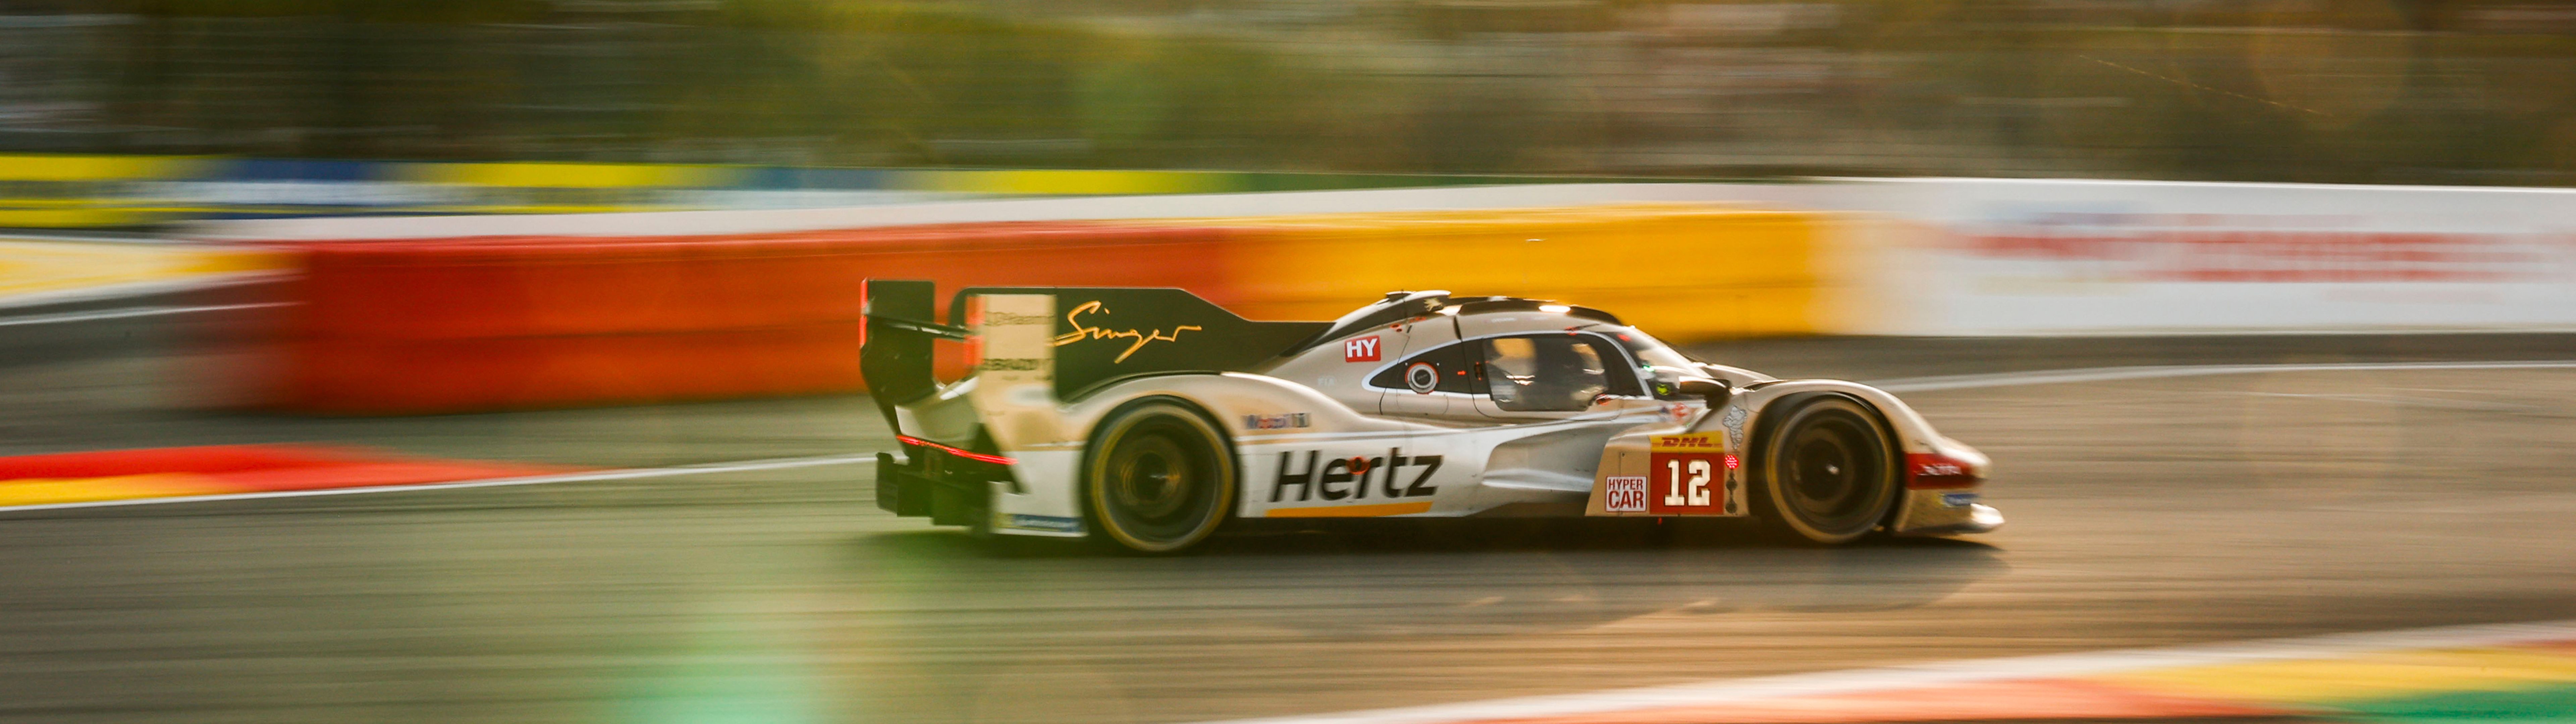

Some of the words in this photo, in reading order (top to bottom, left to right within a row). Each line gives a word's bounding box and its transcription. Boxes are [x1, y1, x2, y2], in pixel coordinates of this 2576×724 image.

[1047, 300, 1202, 364] Singer
[1346, 338, 1378, 358] HY
[1661, 437, 1713, 447] DHL
[1268, 447, 1443, 502] Hertz
[1608, 479, 1643, 490] HYPER
[1664, 459, 1711, 506] 12
[1608, 490, 1644, 509] CAR
